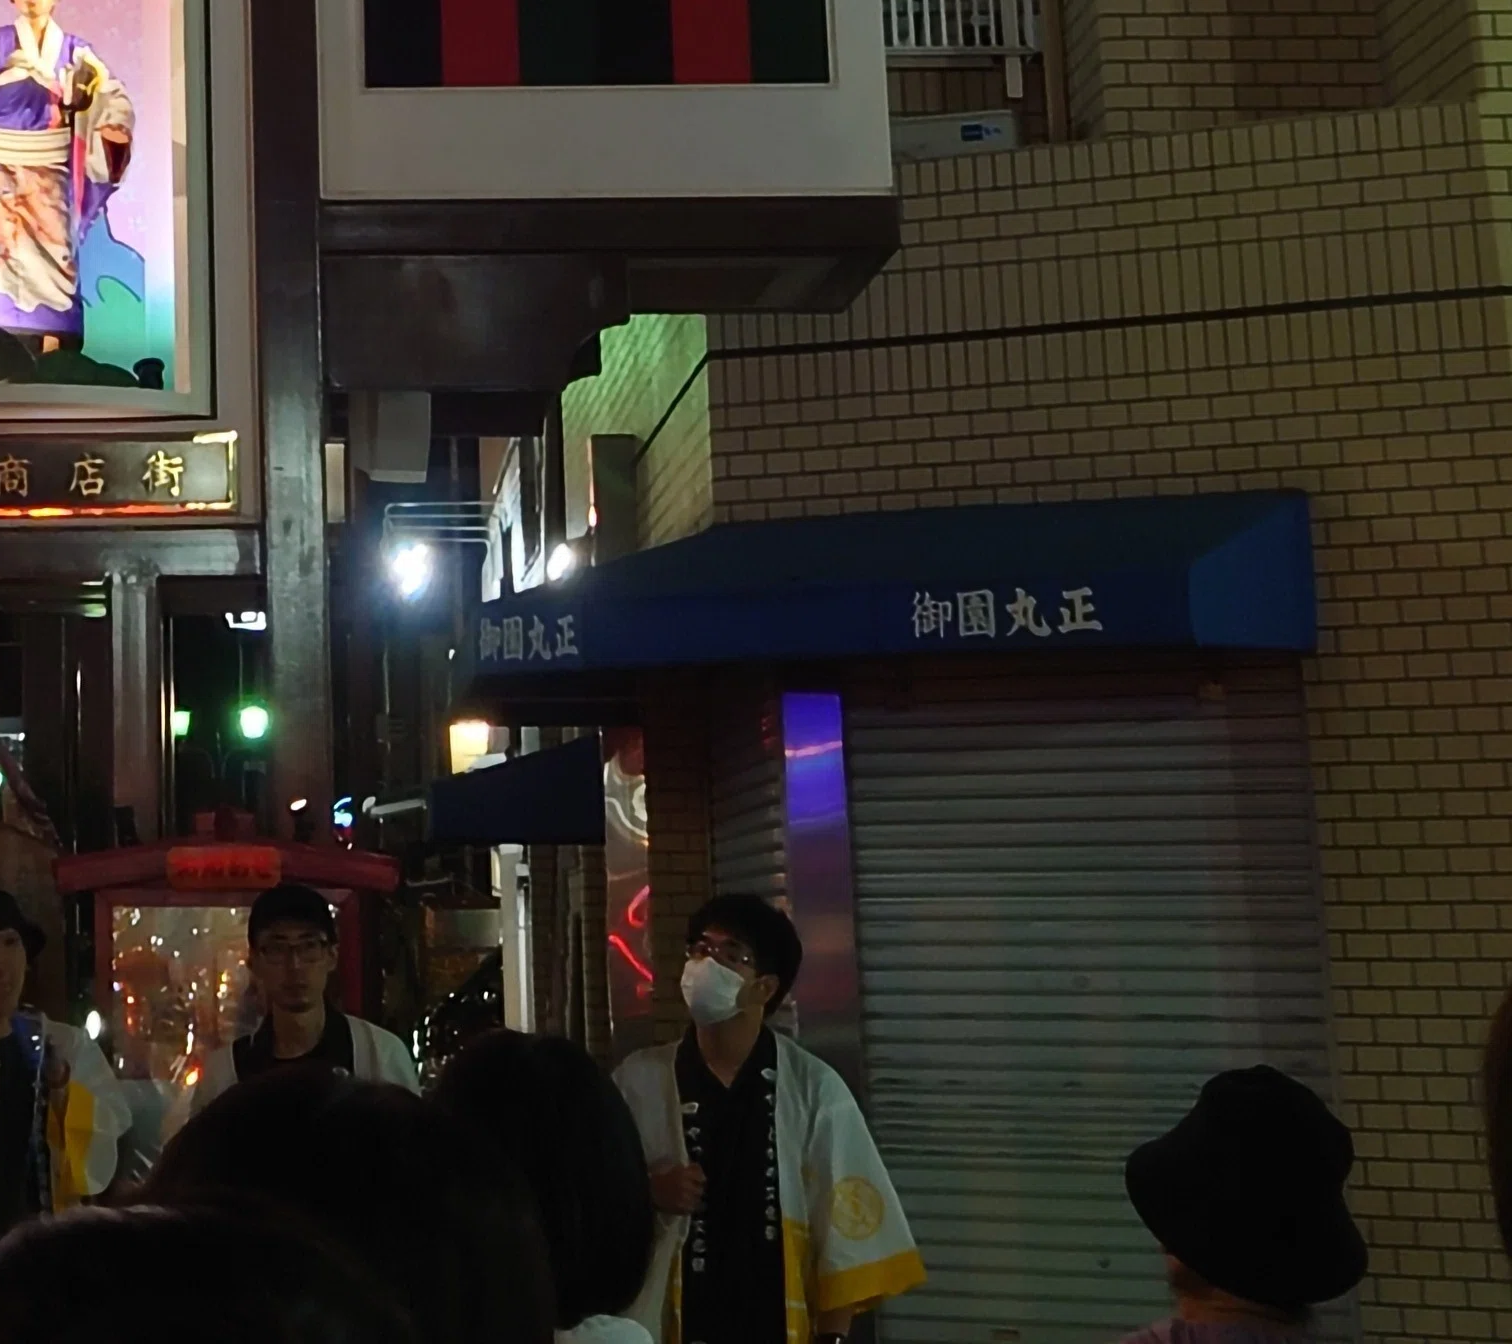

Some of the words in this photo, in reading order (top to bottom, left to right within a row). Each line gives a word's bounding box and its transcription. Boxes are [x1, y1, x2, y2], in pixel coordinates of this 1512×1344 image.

[479, 613, 580, 662] 御園丸正
[911, 585, 1104, 639] 御園丸正
